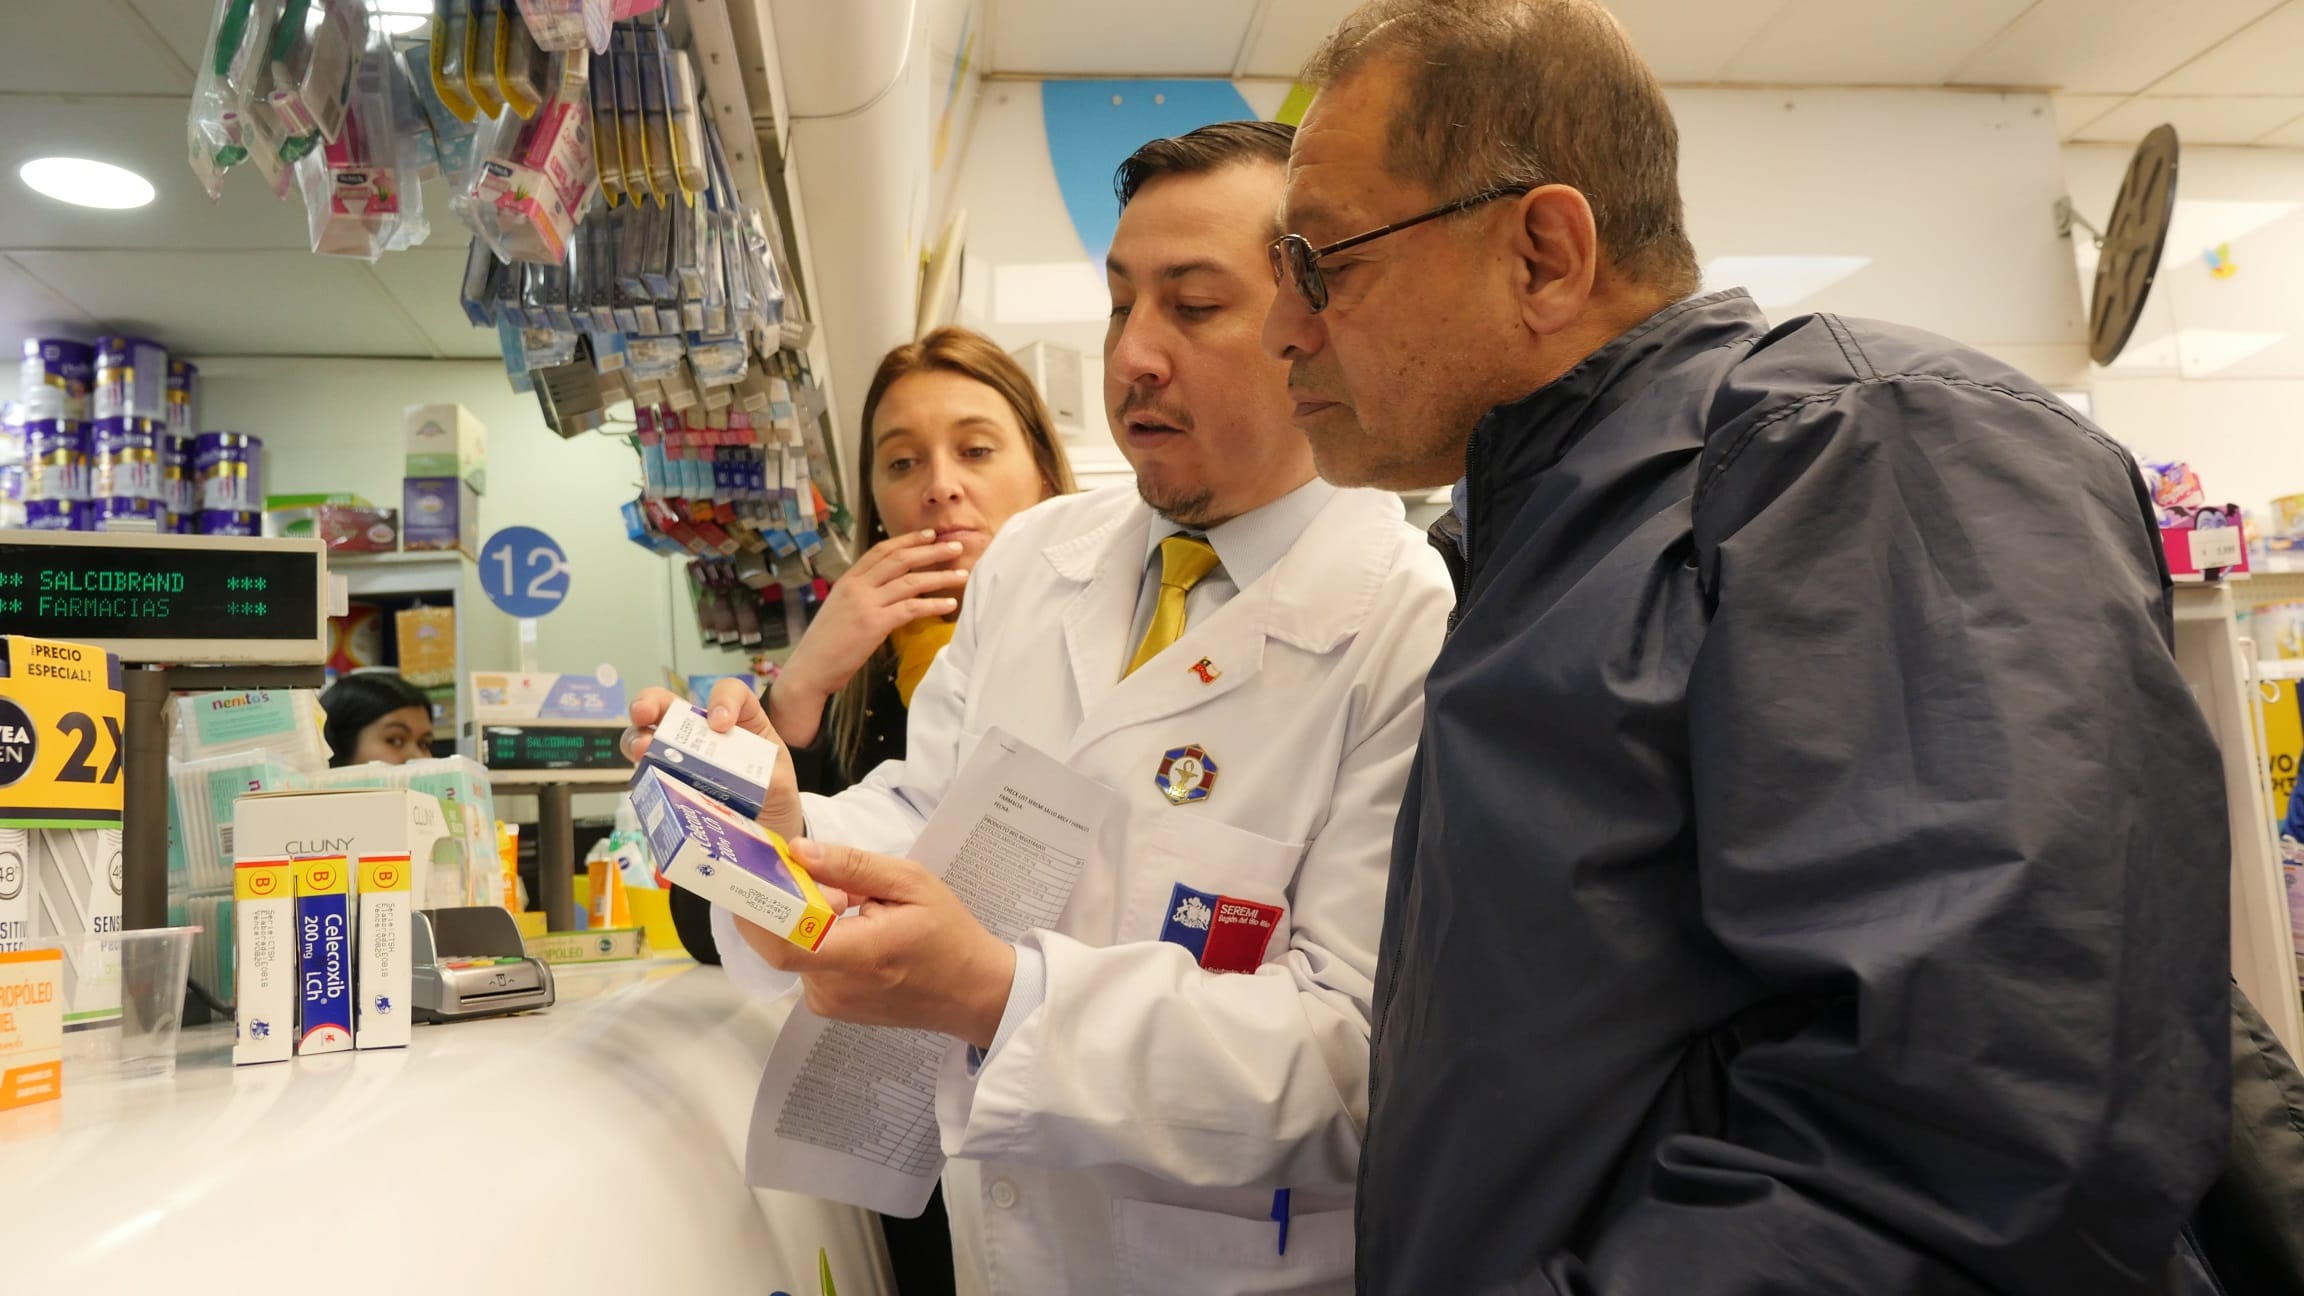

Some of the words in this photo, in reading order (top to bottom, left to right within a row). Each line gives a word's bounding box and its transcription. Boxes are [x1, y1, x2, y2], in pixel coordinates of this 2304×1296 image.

[492, 545, 562, 599] 12
[40, 571, 184, 593] SALCOBRAND
[39, 596, 170, 617] FARMACIAS
[28, 663, 92, 682] ESPECIAL!
[285, 837, 354, 855] CLUNY
[256, 877, 270, 887] B
[313, 871, 329, 882] B
[378, 871, 393, 881] B
[1220, 904, 1259, 918] SEREMI
[304, 915, 319, 942] 200
[804, 919, 815, 933] B
[303, 943, 313, 959] mg
[324, 913, 345, 999] Celecoxib
